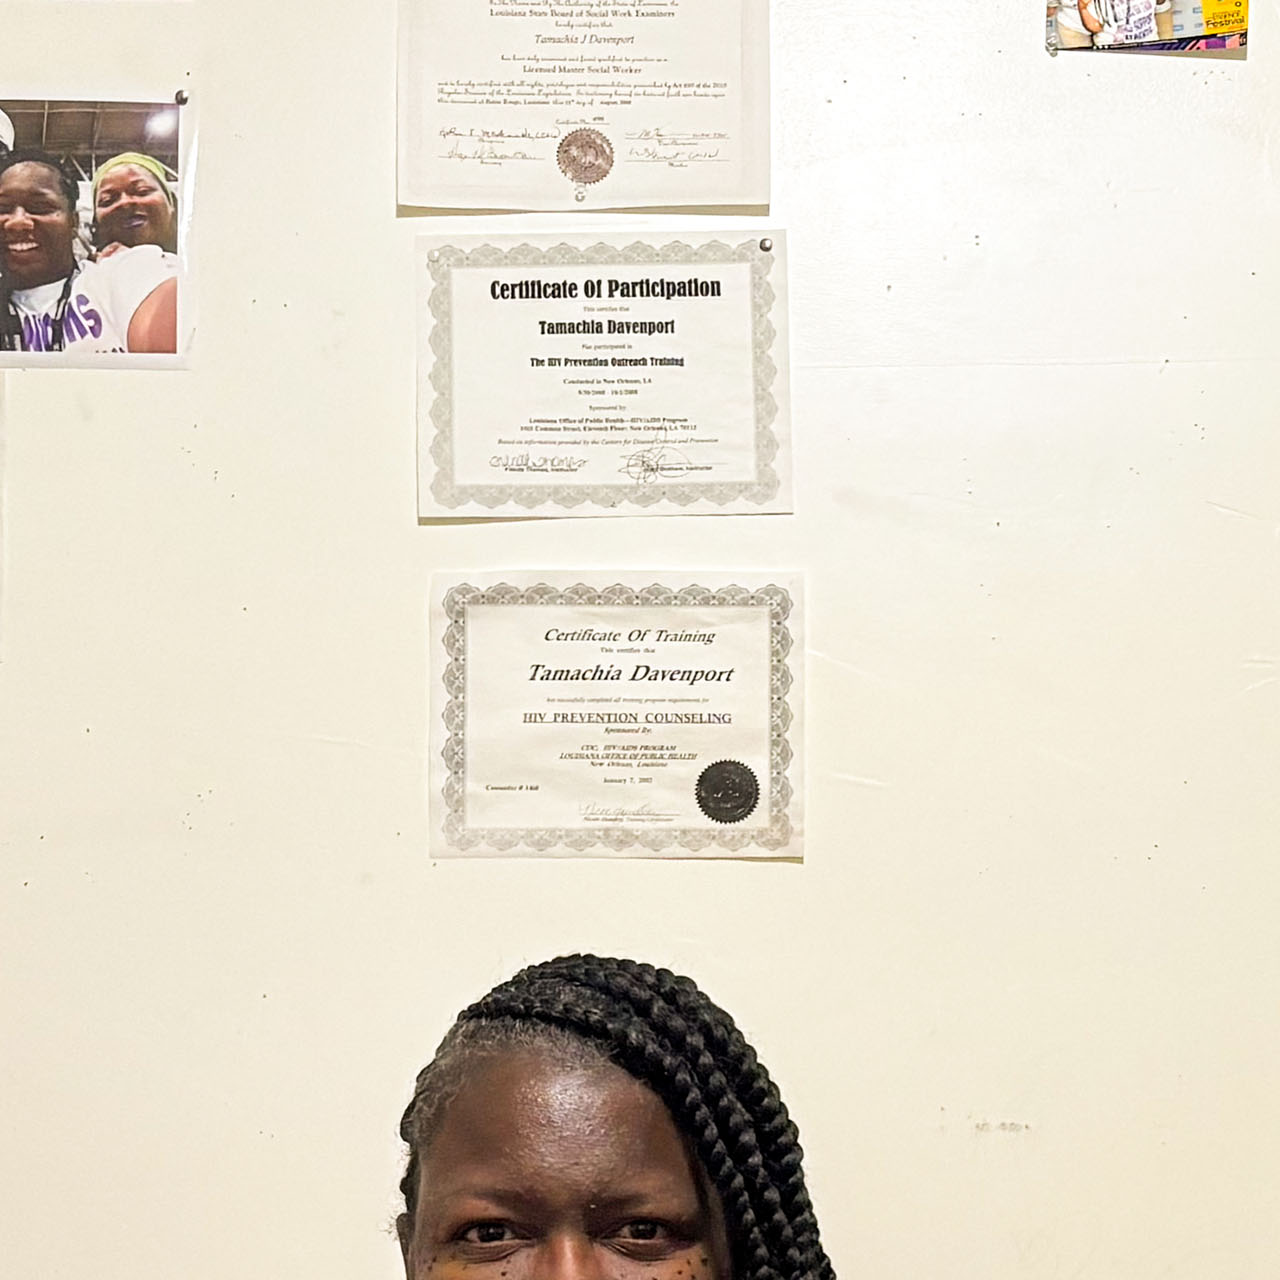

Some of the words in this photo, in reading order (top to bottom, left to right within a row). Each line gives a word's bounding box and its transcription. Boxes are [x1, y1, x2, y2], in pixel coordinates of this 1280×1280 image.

[490, 280, 578, 300] Certificate
[583, 279, 603, 299] Of
[607, 278, 722, 300] Participation
[538, 320, 604, 335] Tamachia
[607, 319, 676, 336] Davenport
[544, 629, 622, 642] Certificate
[627, 629, 651, 642] Of
[655, 629, 716, 645] Training
[528, 664, 622, 682] Tamachia
[629, 665, 735, 685] Davenport
[523, 712, 546, 723] HIV
[552, 712, 638, 723] PREVENTION
[645, 712, 732, 723] COUNSELING
